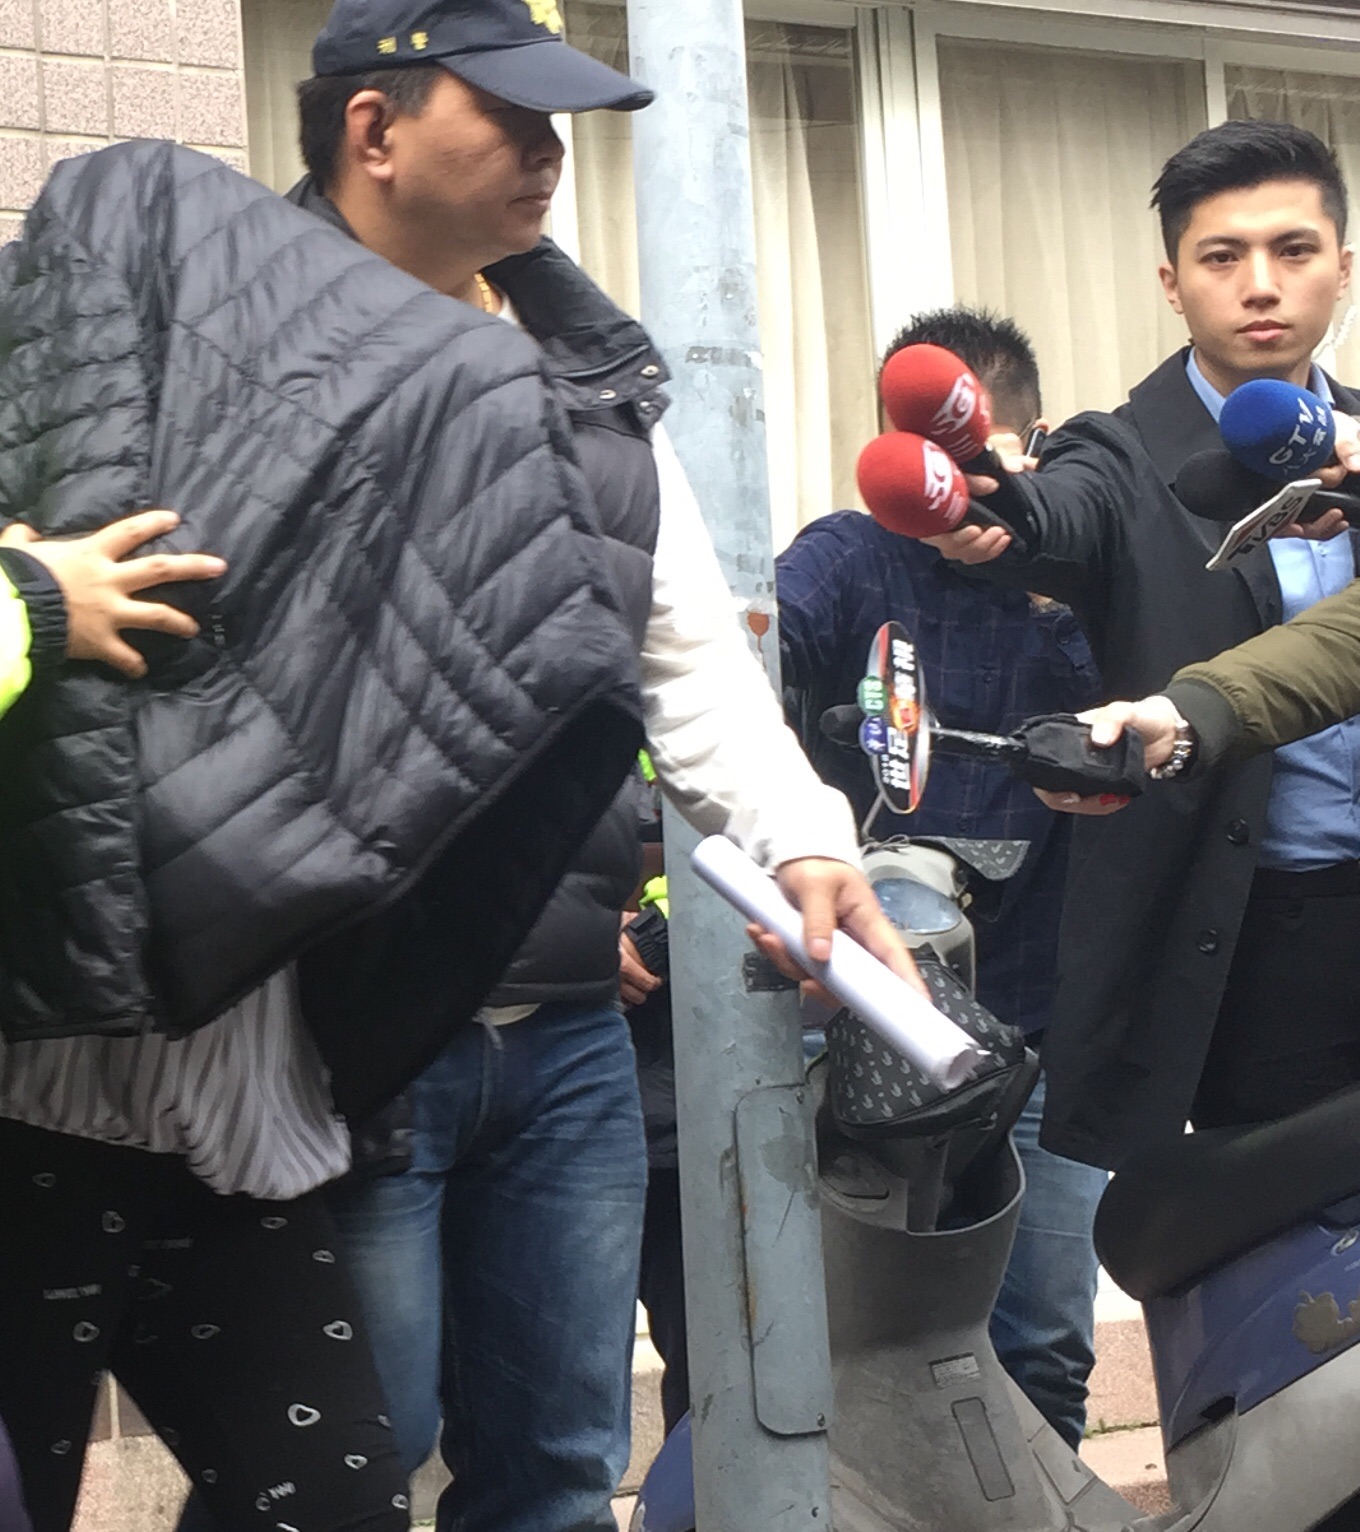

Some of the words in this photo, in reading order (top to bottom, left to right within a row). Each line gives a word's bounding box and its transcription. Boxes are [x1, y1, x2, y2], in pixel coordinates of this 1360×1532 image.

[1269, 397, 1314, 465] GTV
[1226, 496, 1304, 561] TVBS
[864, 680, 885, 711] CTS
